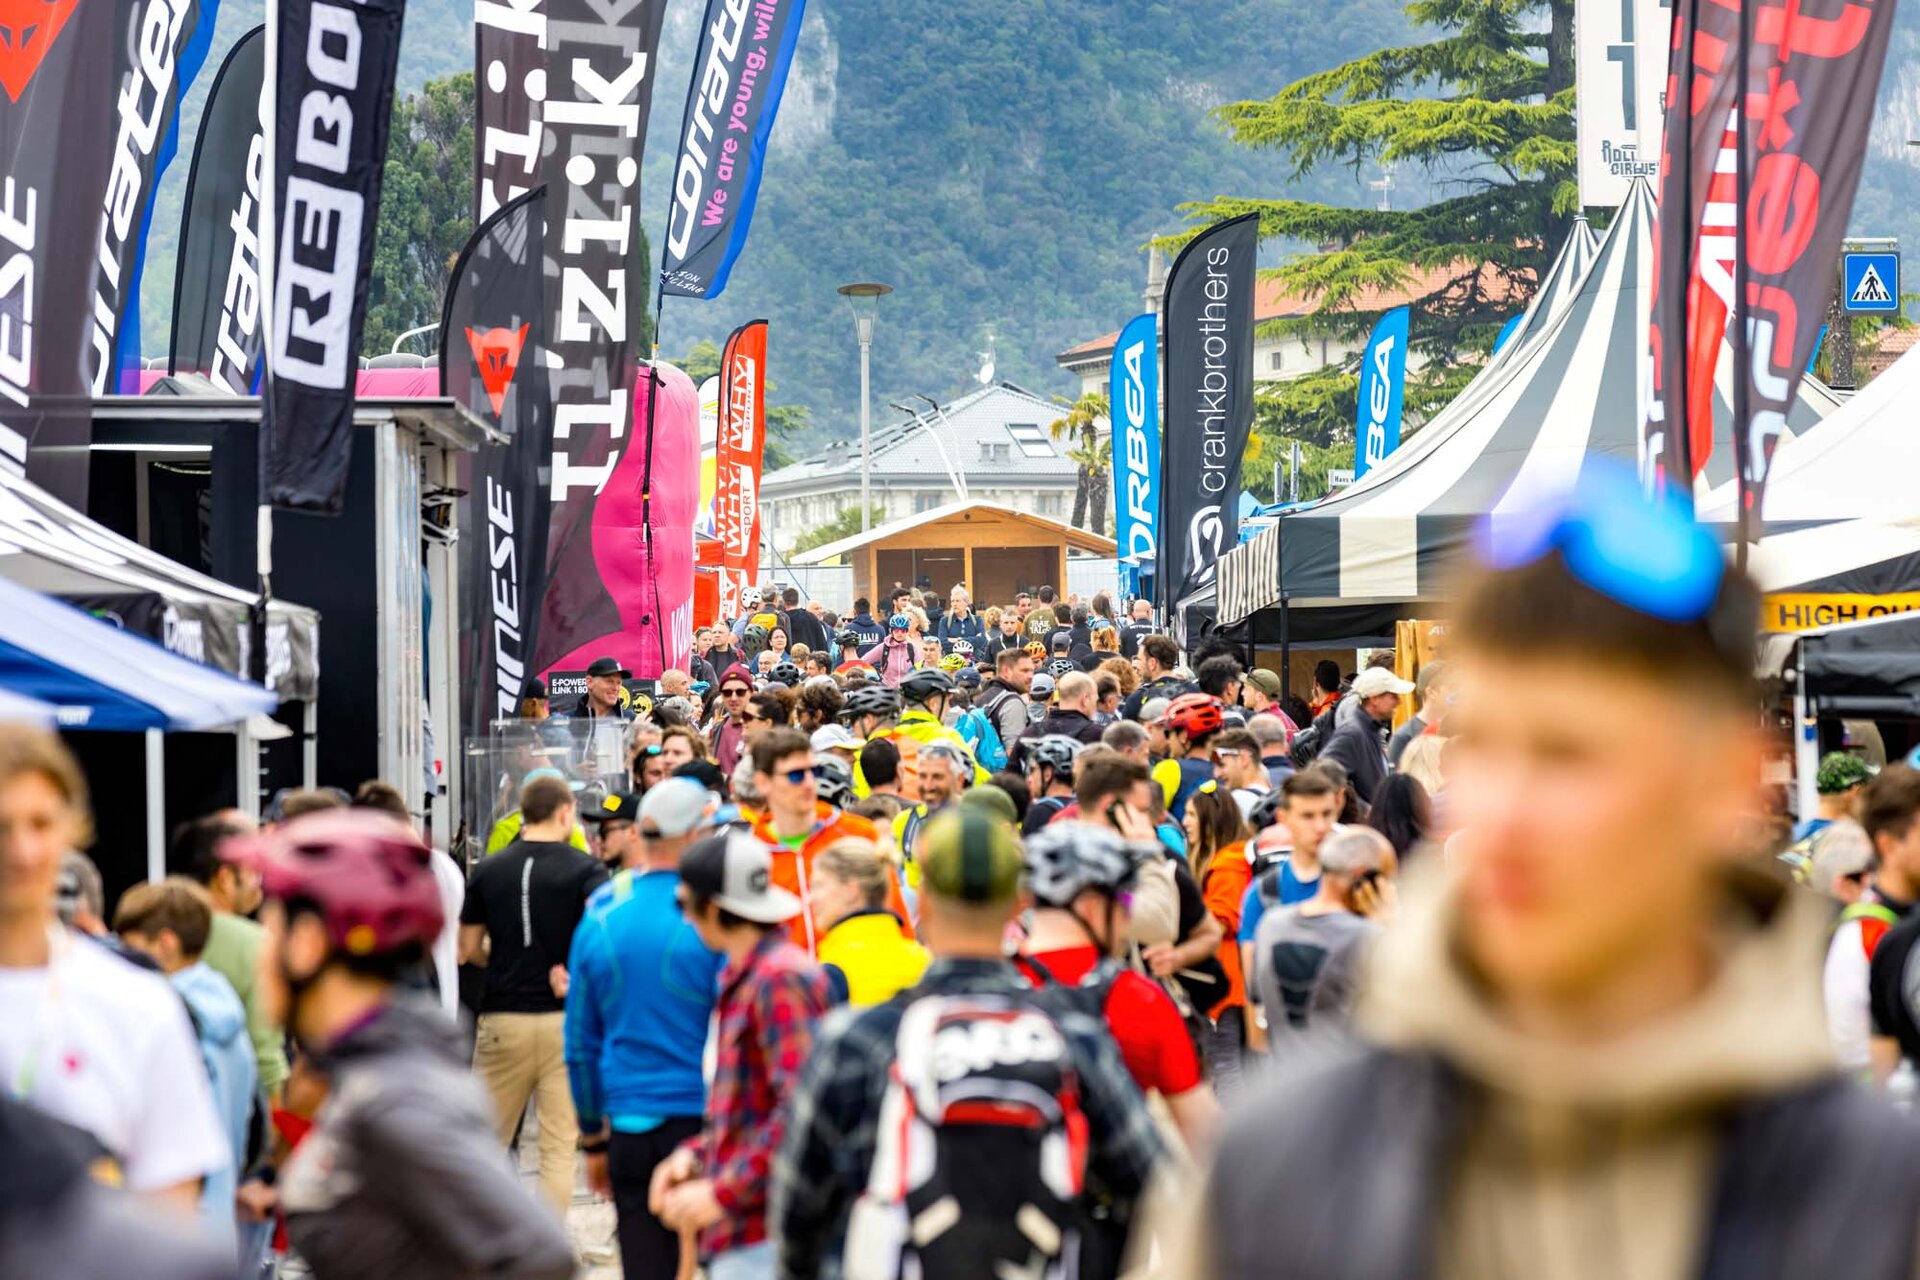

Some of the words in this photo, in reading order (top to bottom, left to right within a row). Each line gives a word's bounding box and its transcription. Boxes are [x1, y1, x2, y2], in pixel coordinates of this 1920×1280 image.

[273, 0, 366, 390] REBO
[702, 189, 727, 226] We
[718, 137, 738, 182] are
[728, 46, 768, 133] young,
[1198, 246, 1230, 492] crankbrothers
[1365, 335, 1395, 469] BEA
[742, 486, 753, 536] SPORT
[1779, 604, 1858, 626] HIGH
[574, 686, 589, 695] 180
